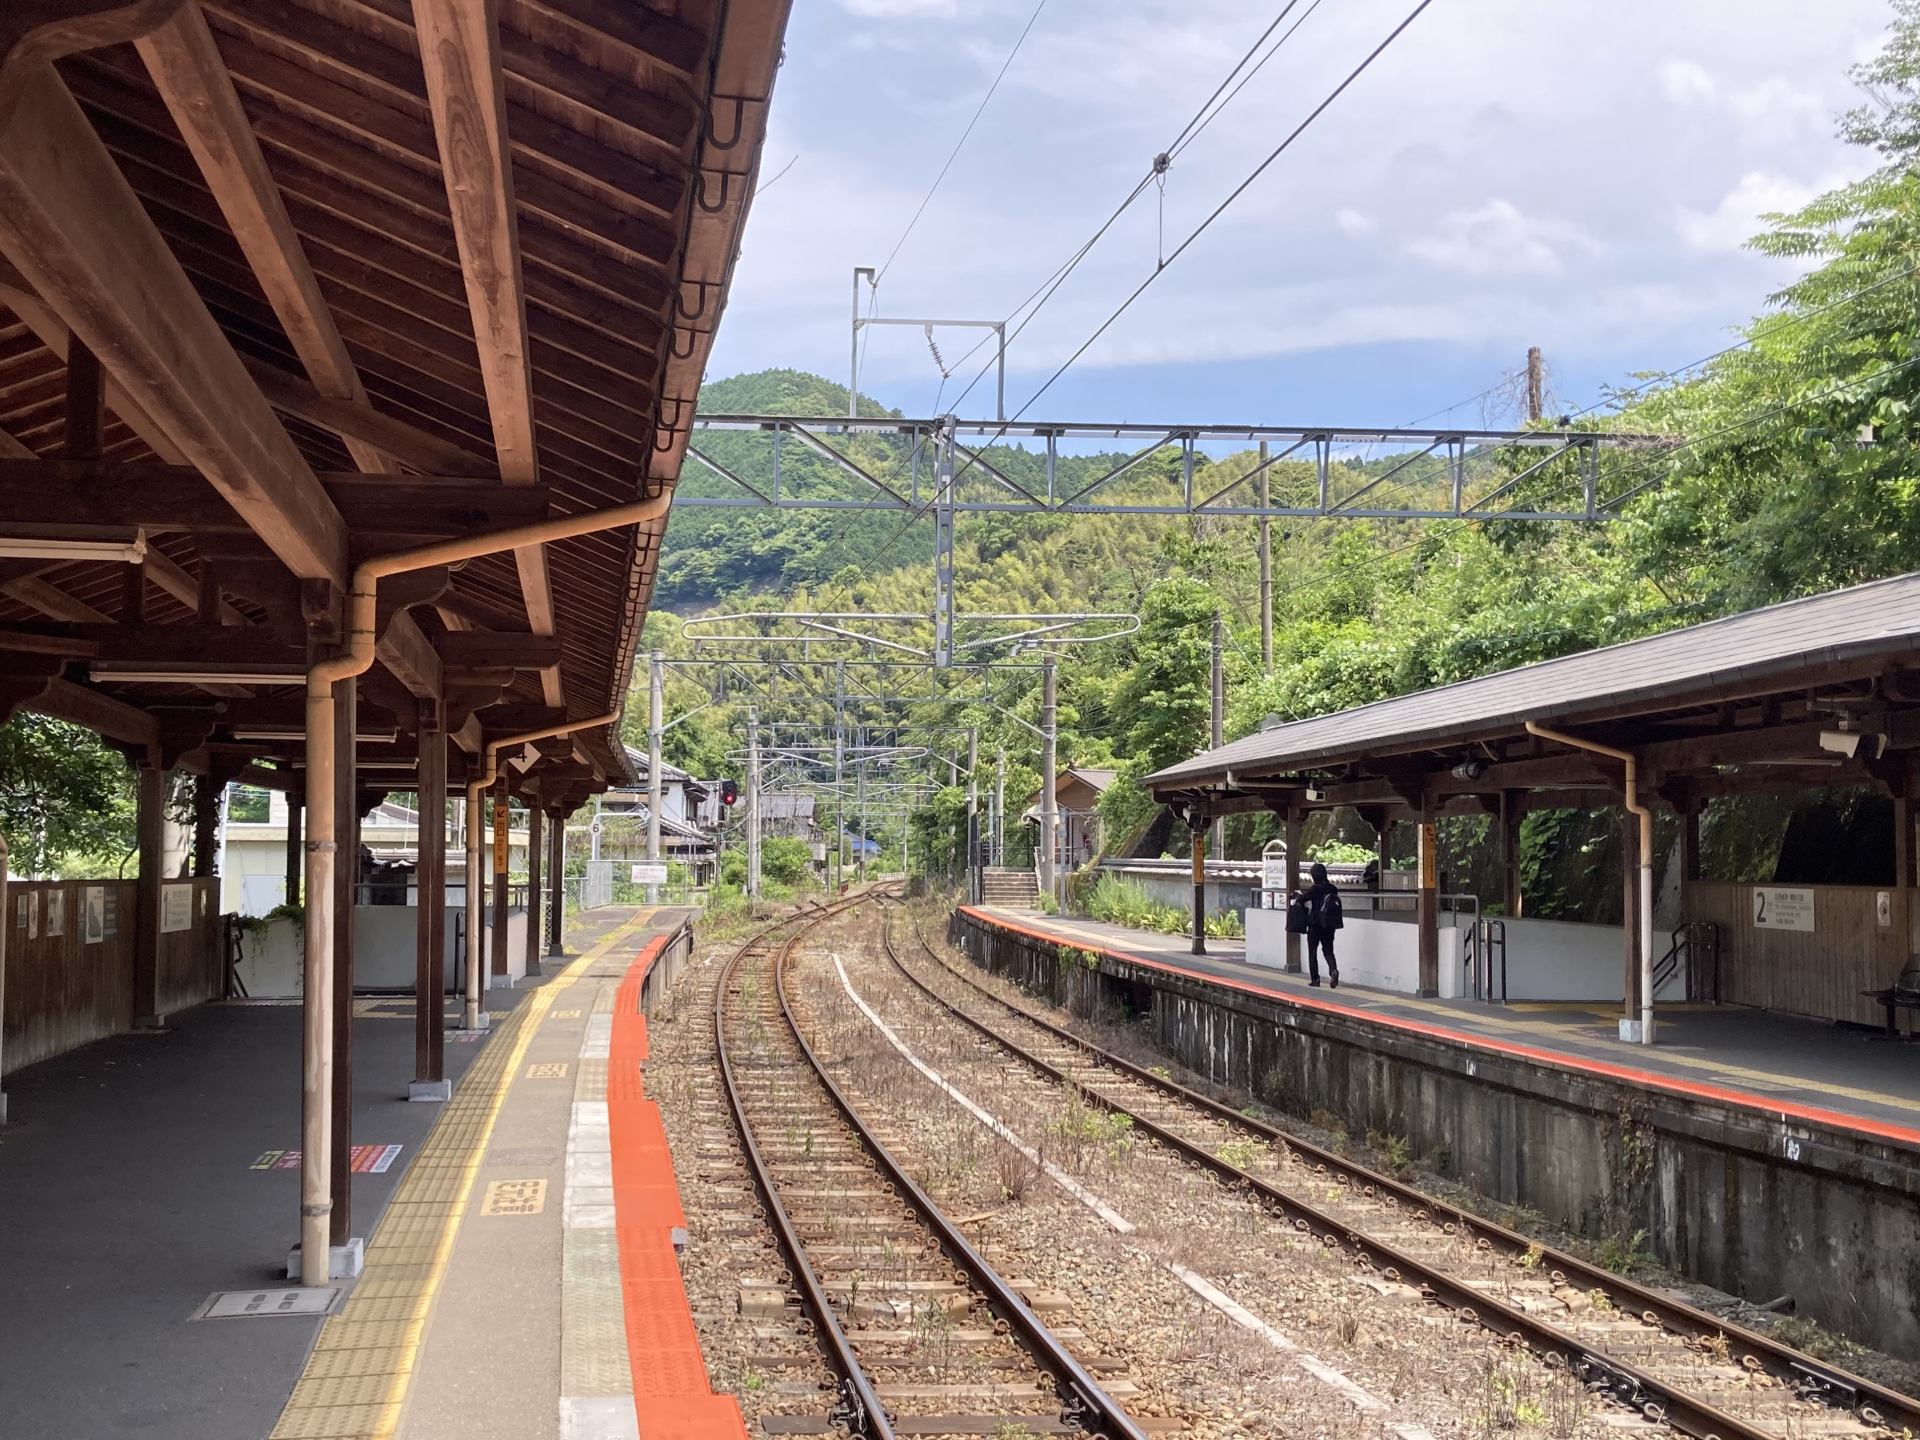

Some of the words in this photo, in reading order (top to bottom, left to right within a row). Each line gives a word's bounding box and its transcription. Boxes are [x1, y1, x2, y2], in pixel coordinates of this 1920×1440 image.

[514, 750, 528, 763] 4
[496, 820, 505, 837] 出口
[592, 823, 600, 833] 6
[1756, 891, 1767, 923] 2
[490, 1181, 539, 1214] 足元注意
